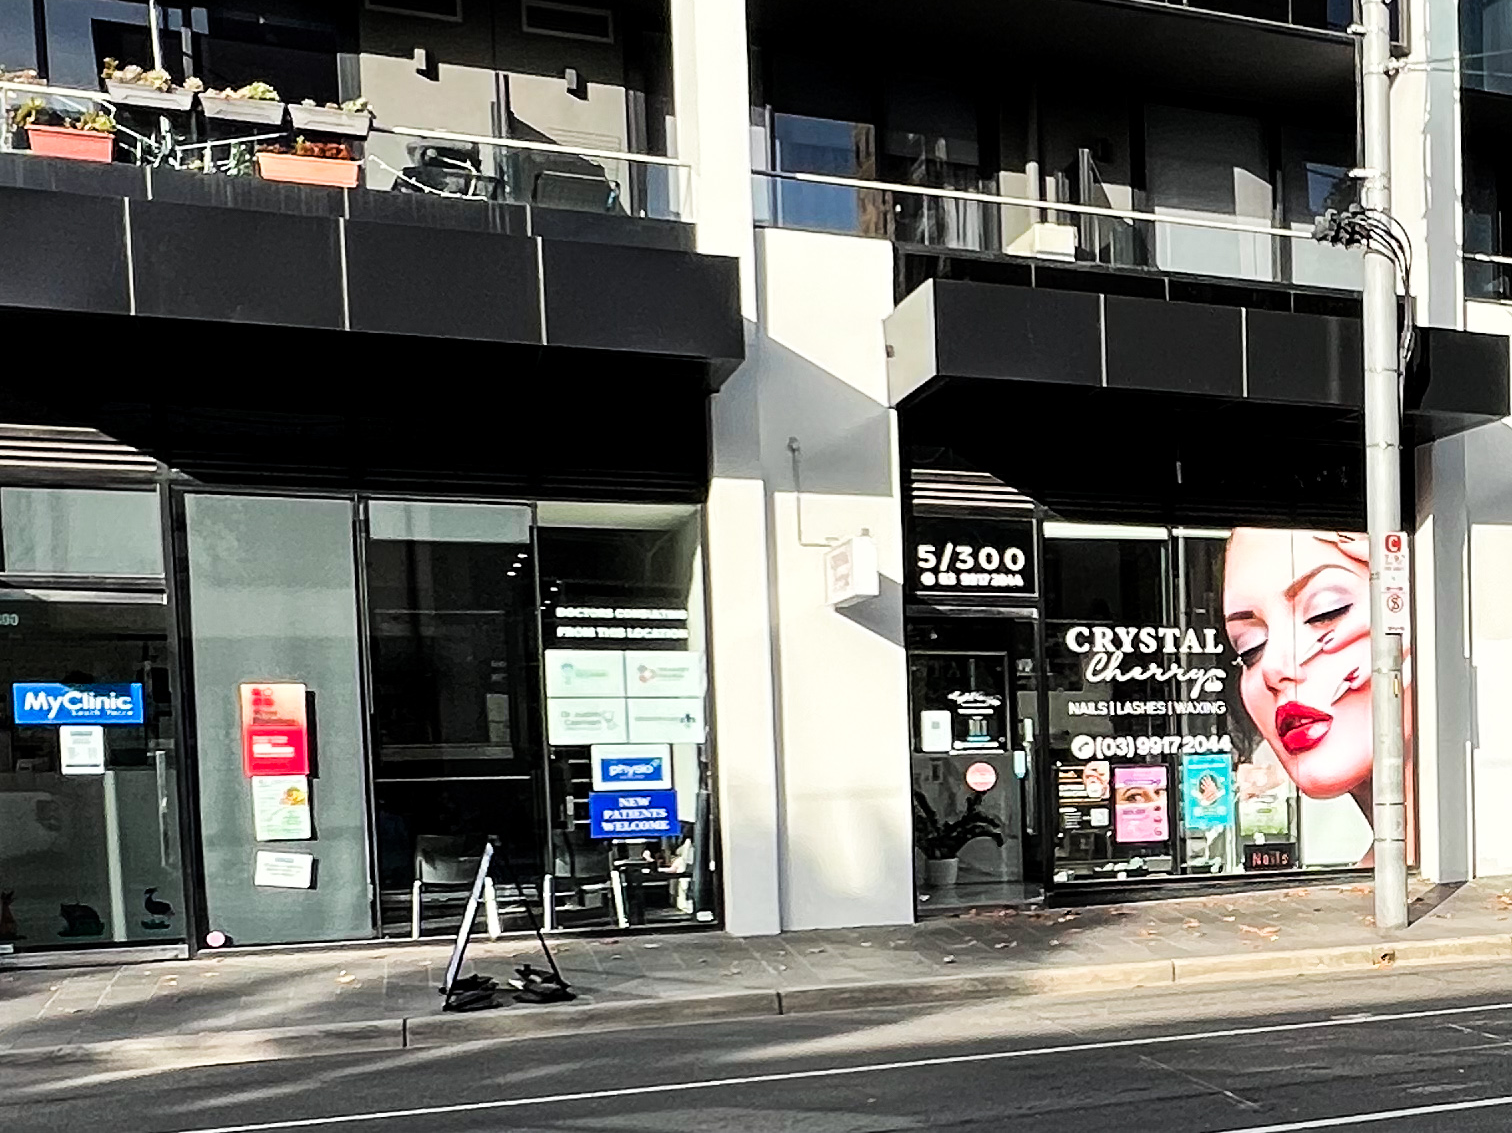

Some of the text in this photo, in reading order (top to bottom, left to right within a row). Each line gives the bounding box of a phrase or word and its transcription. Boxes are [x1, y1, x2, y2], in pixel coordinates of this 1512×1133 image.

[917, 541, 1026, 571] 5/300
[557, 627, 596, 637] FROM
[597, 627, 626, 638] THIS
[1065, 626, 1224, 654] CRYSTAL
[1086, 651, 1212, 699] Cherry
[24, 691, 133, 719] MyClinic
[1068, 701, 1227, 716] NAILS LASHES WAXING
[1095, 734, 1232, 759] (03) 9917 2044
[618, 797, 652, 808] NEW
[603, 808, 668, 820] PATIENTS
[601, 821, 671, 832] WELCOME
